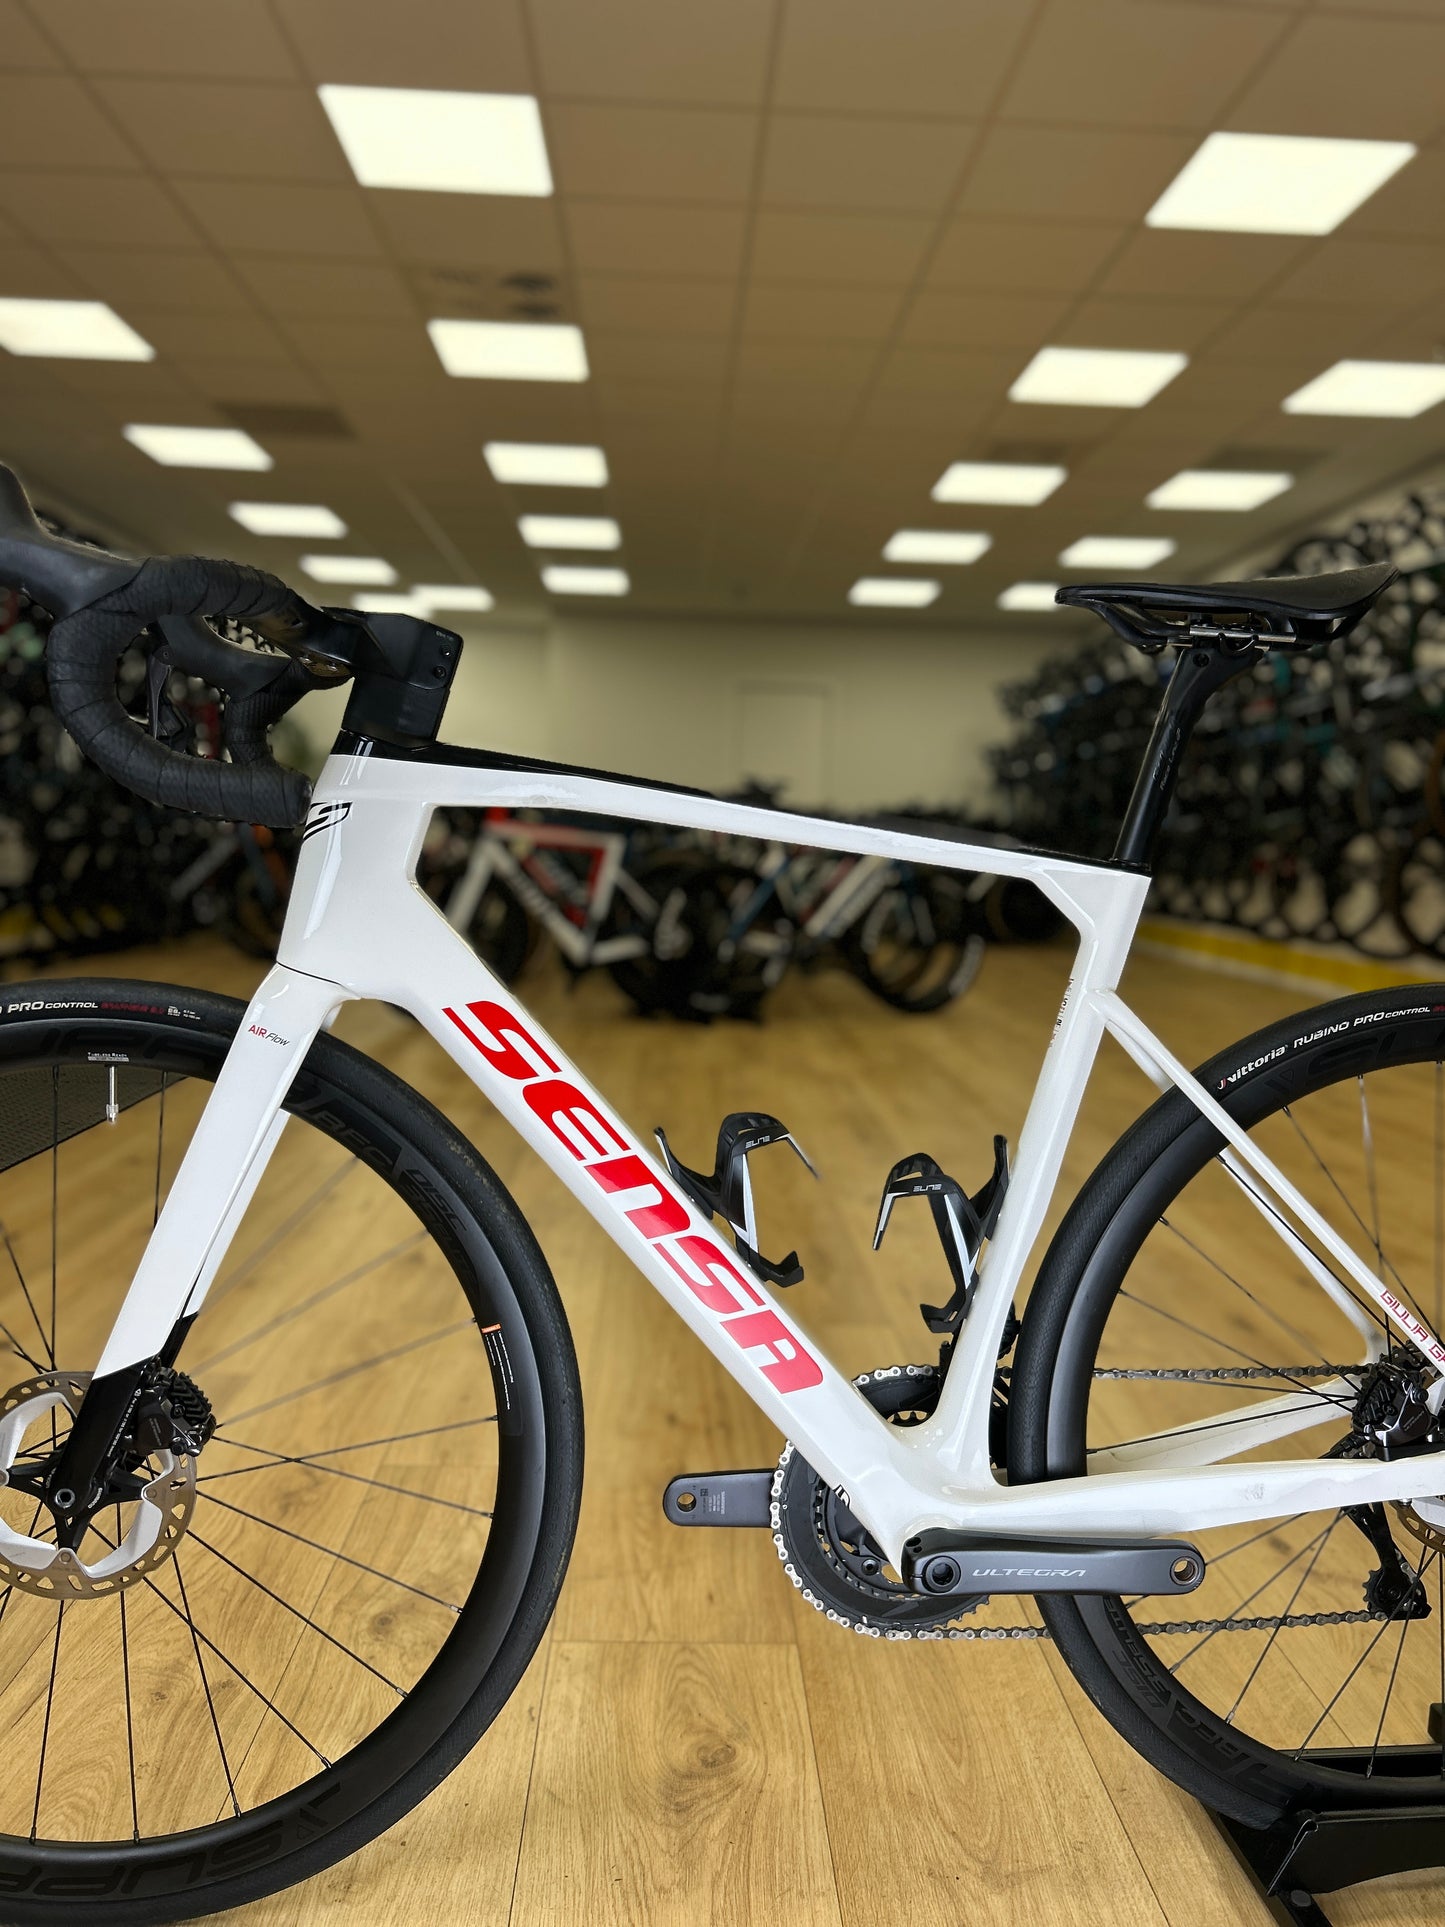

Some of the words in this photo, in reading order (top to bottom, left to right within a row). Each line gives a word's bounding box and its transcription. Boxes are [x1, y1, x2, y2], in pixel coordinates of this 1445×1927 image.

[8, 1001, 45, 1014] PRO
[45, 1002, 99, 1010] CONTROL
[248, 1024, 268, 1038] AIR
[265, 1032, 290, 1046] Flow
[1225, 1045, 1287, 1083] vittoria
[1294, 1020, 1350, 1049] RUBINO
[1353, 1011, 1385, 1027] PRO
[1385, 1006, 1431, 1019] CONTROL
[441, 1000, 824, 1394] SENSA
[1380, 1289, 1429, 1342] GIULIA
[972, 1568, 1087, 1577] ULTEGRA
